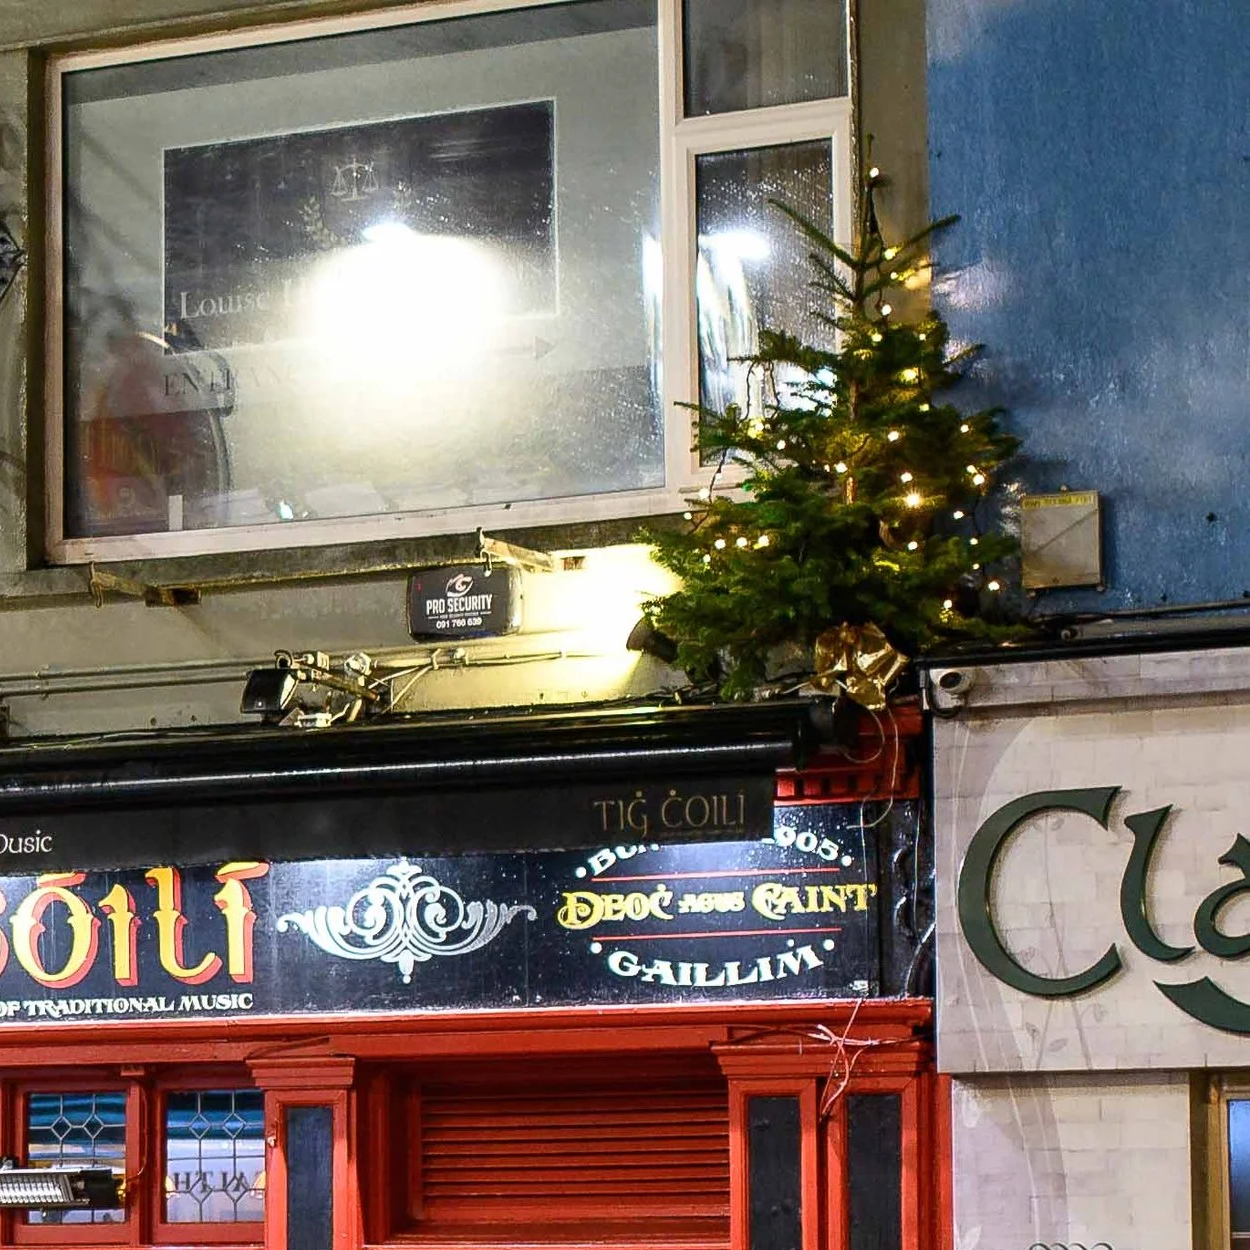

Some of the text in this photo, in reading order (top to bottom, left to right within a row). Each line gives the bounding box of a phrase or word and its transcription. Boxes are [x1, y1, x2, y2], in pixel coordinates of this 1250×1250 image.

[426, 594, 493, 615] PRO SECURITY
[761, 825, 840, 862] 905
[23, 997, 176, 1019] TRADITIONAL
[178, 993, 254, 1013] MUSIC
